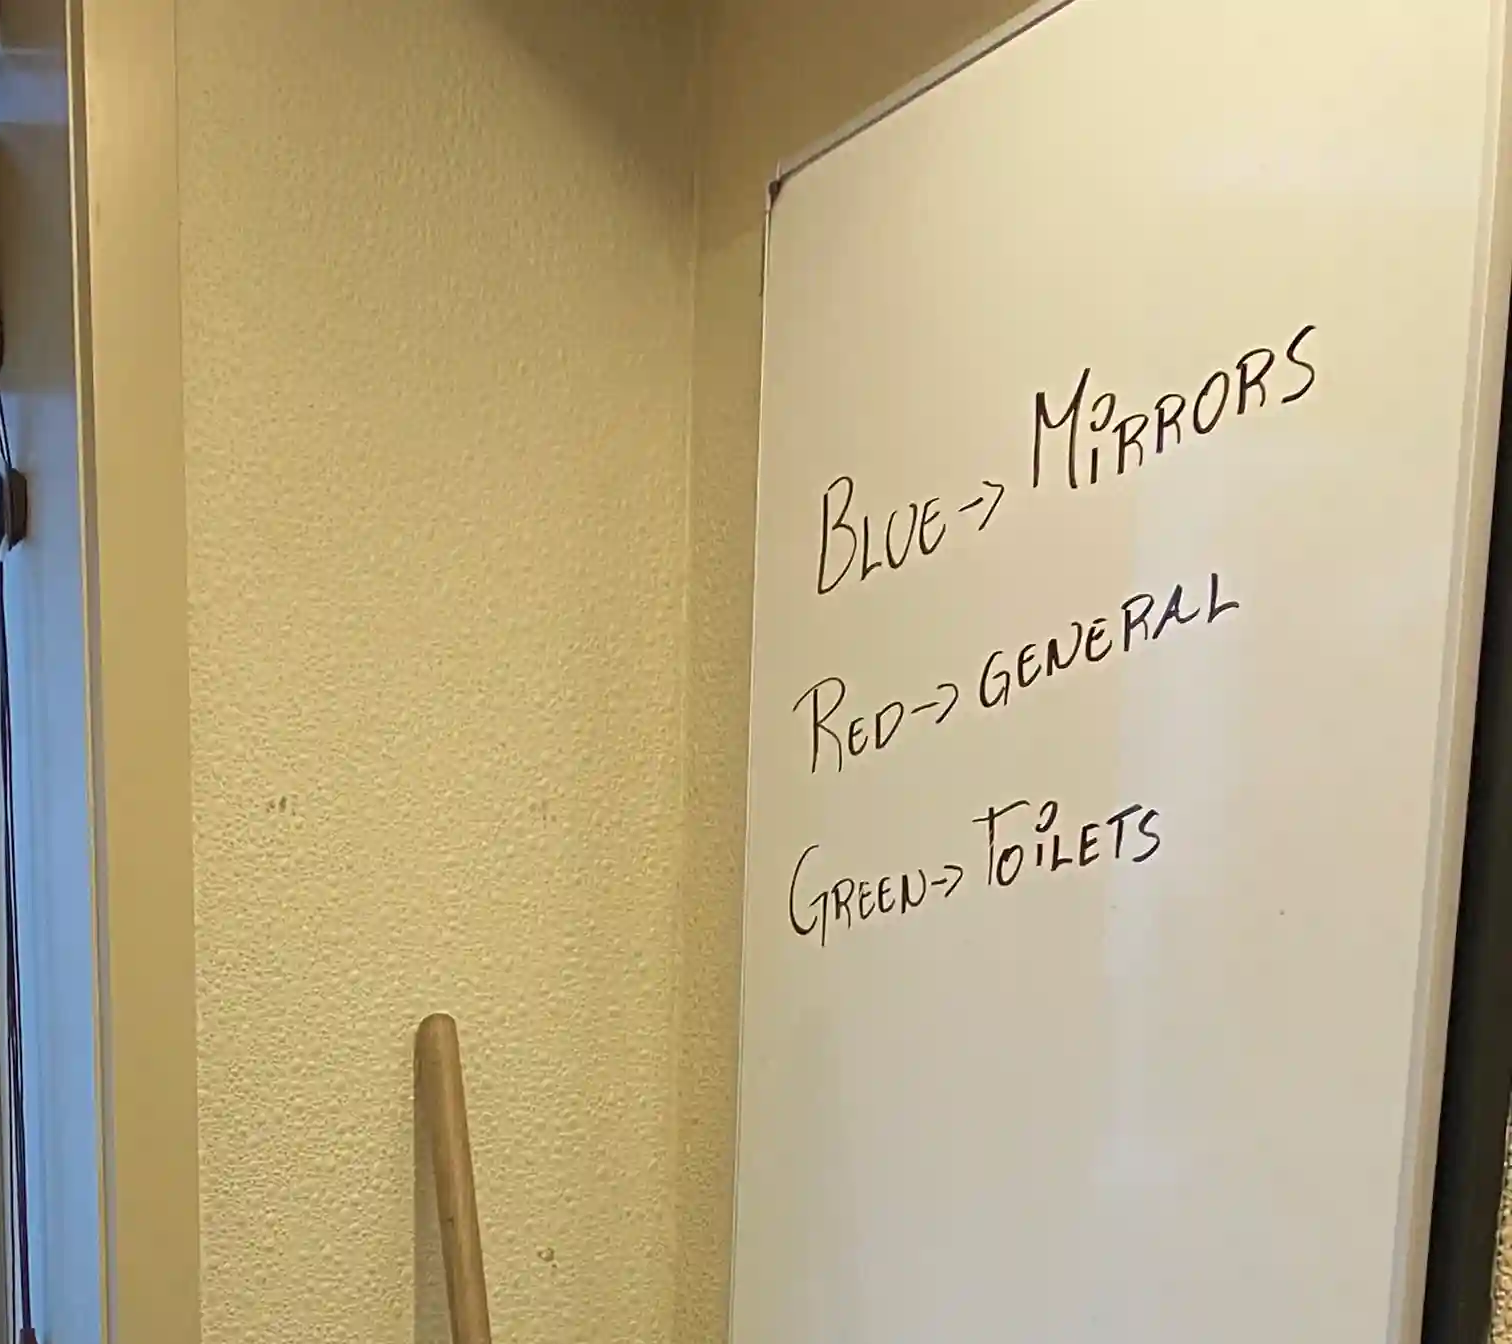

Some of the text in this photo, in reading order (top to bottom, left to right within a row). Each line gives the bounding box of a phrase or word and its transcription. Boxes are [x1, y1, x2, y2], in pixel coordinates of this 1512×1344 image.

[817, 475, 947, 596] BLUE
[979, 572, 1240, 709] GENERAL
[789, 844, 927, 948] GREEN
